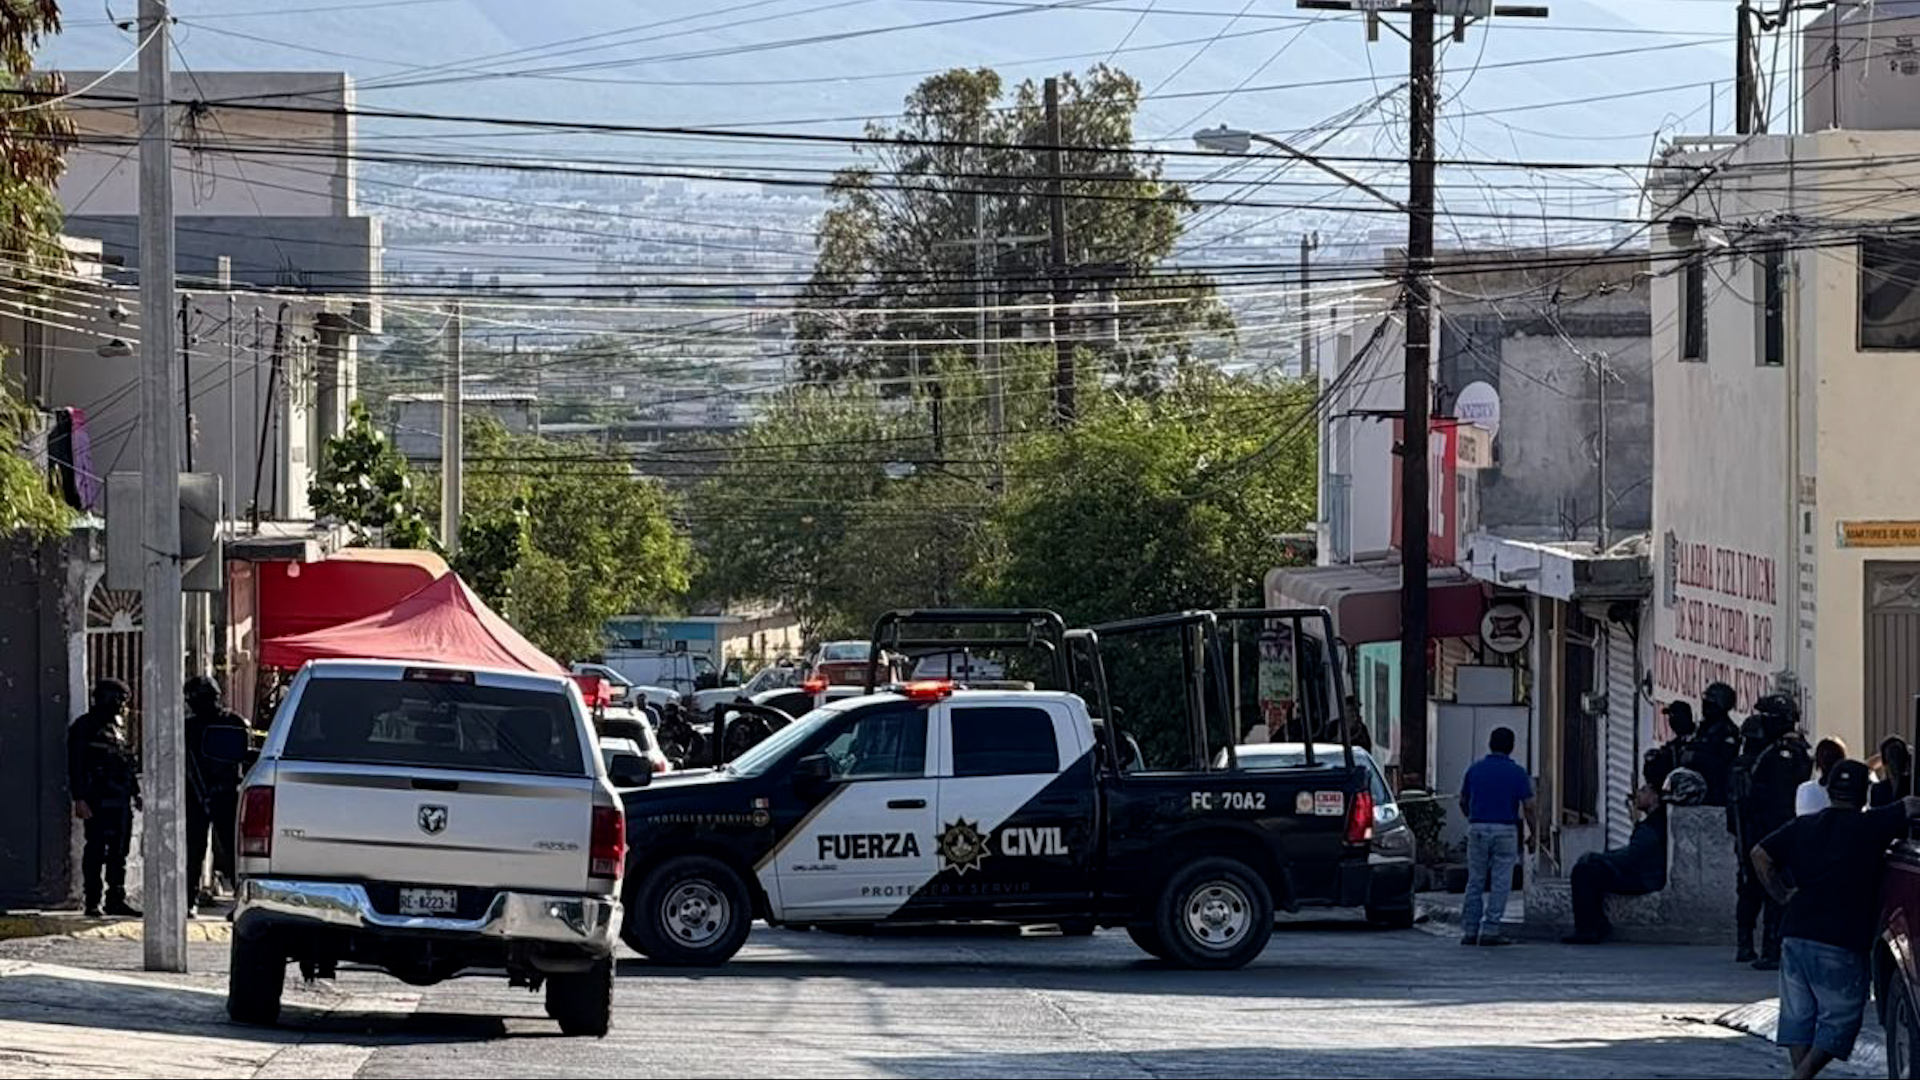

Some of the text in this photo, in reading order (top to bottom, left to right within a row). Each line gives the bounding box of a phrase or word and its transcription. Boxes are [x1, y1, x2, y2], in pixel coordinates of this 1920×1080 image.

[1753, 614, 1771, 663] POR
[1221, 791, 1267, 811] 70A2
[817, 831, 920, 860] FUERZA
[1001, 826, 1069, 856] CIVIL
[861, 882, 951, 896] PROTEGER
